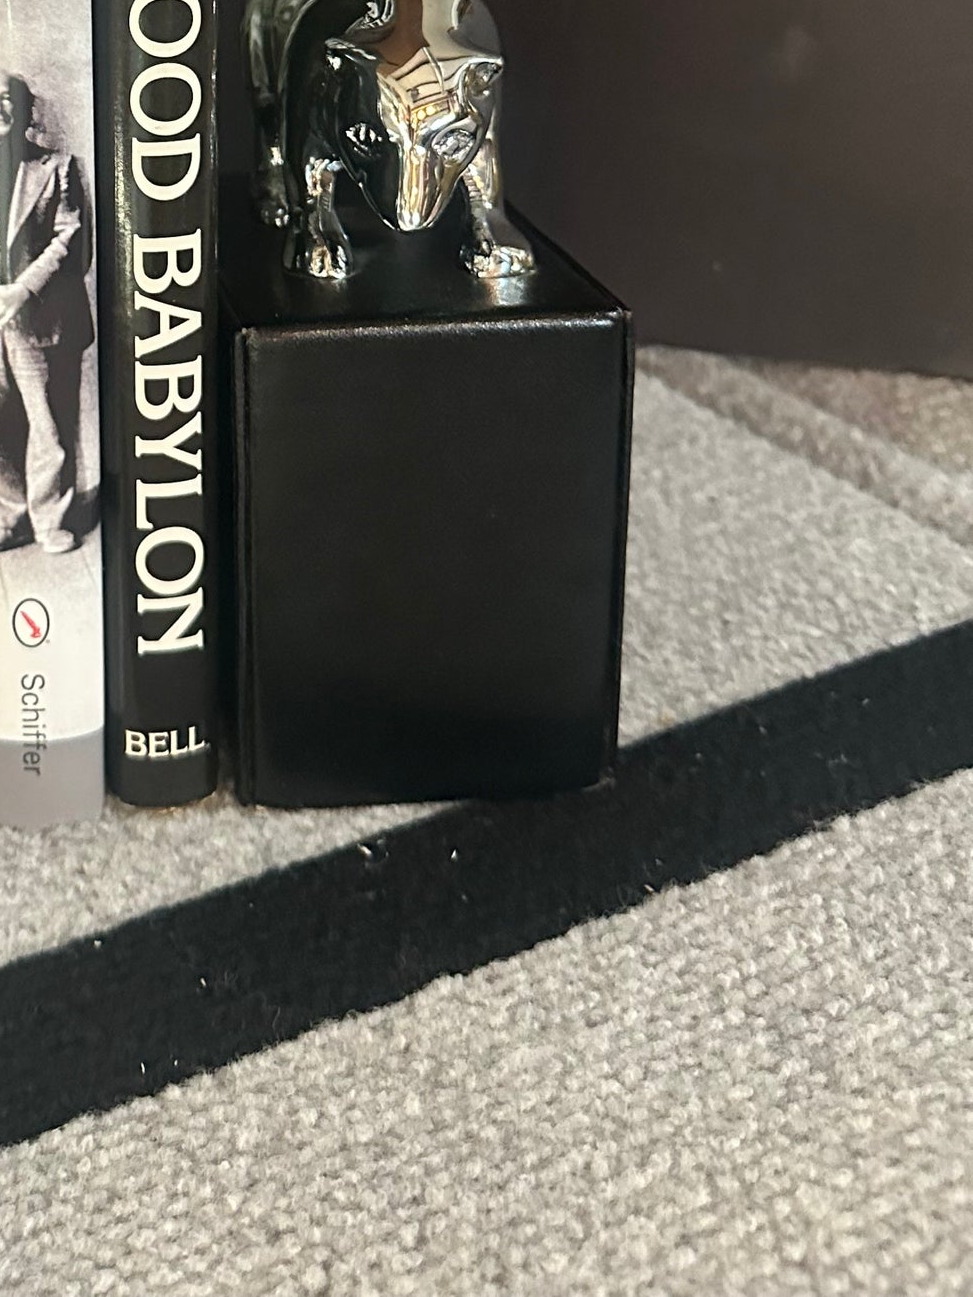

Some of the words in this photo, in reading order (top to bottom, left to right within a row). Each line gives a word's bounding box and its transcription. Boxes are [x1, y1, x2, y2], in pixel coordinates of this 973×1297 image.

[133, 228, 205, 656] BABYLON
[21, 674, 47, 777] Schiffer
[125, 726, 206, 760] BELL
